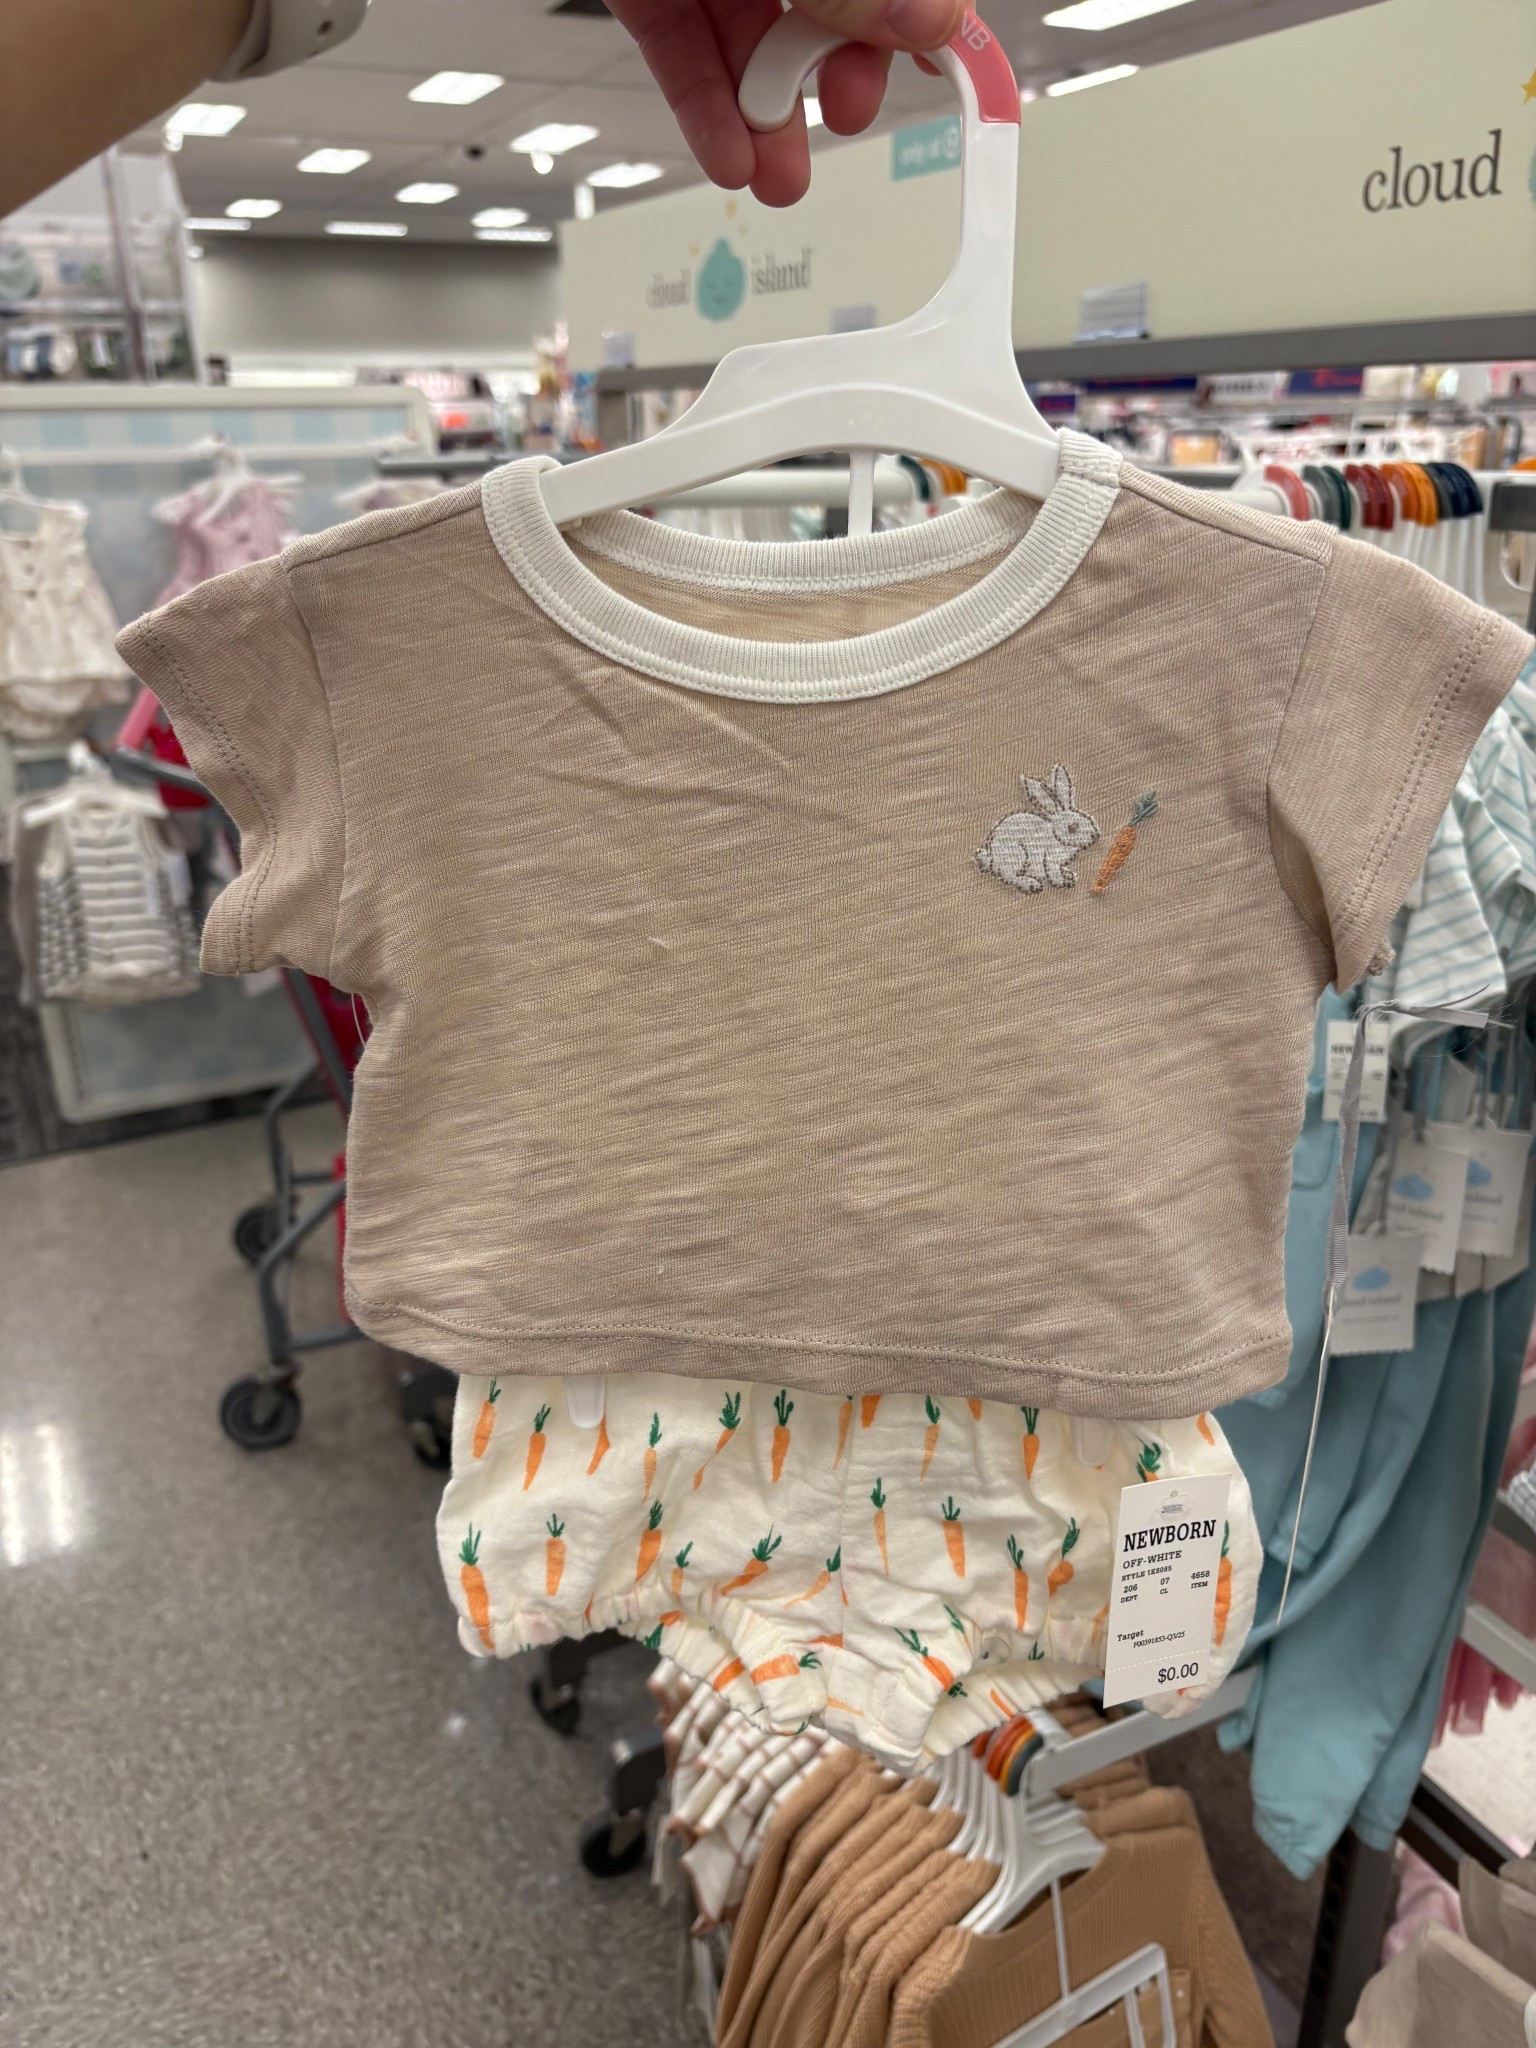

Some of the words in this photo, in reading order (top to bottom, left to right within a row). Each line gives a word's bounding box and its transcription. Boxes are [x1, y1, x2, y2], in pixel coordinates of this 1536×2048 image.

[1361, 127, 1503, 214] cloud
[1123, 1519, 1217, 1552] NEWBORN
[1122, 1549, 1182, 1569] OFF-WHITE
[1121, 1570, 1146, 1582] STYLE
[1123, 1584, 1138, 1594] 206
[1160, 1577, 1170, 1585] 07
[1120, 1594, 1138, 1604] DEPT
[1190, 1581, 1209, 1589] ITEM
[1116, 1630, 1144, 1642] Target
[1157, 1662, 1199, 1684] $0.00
